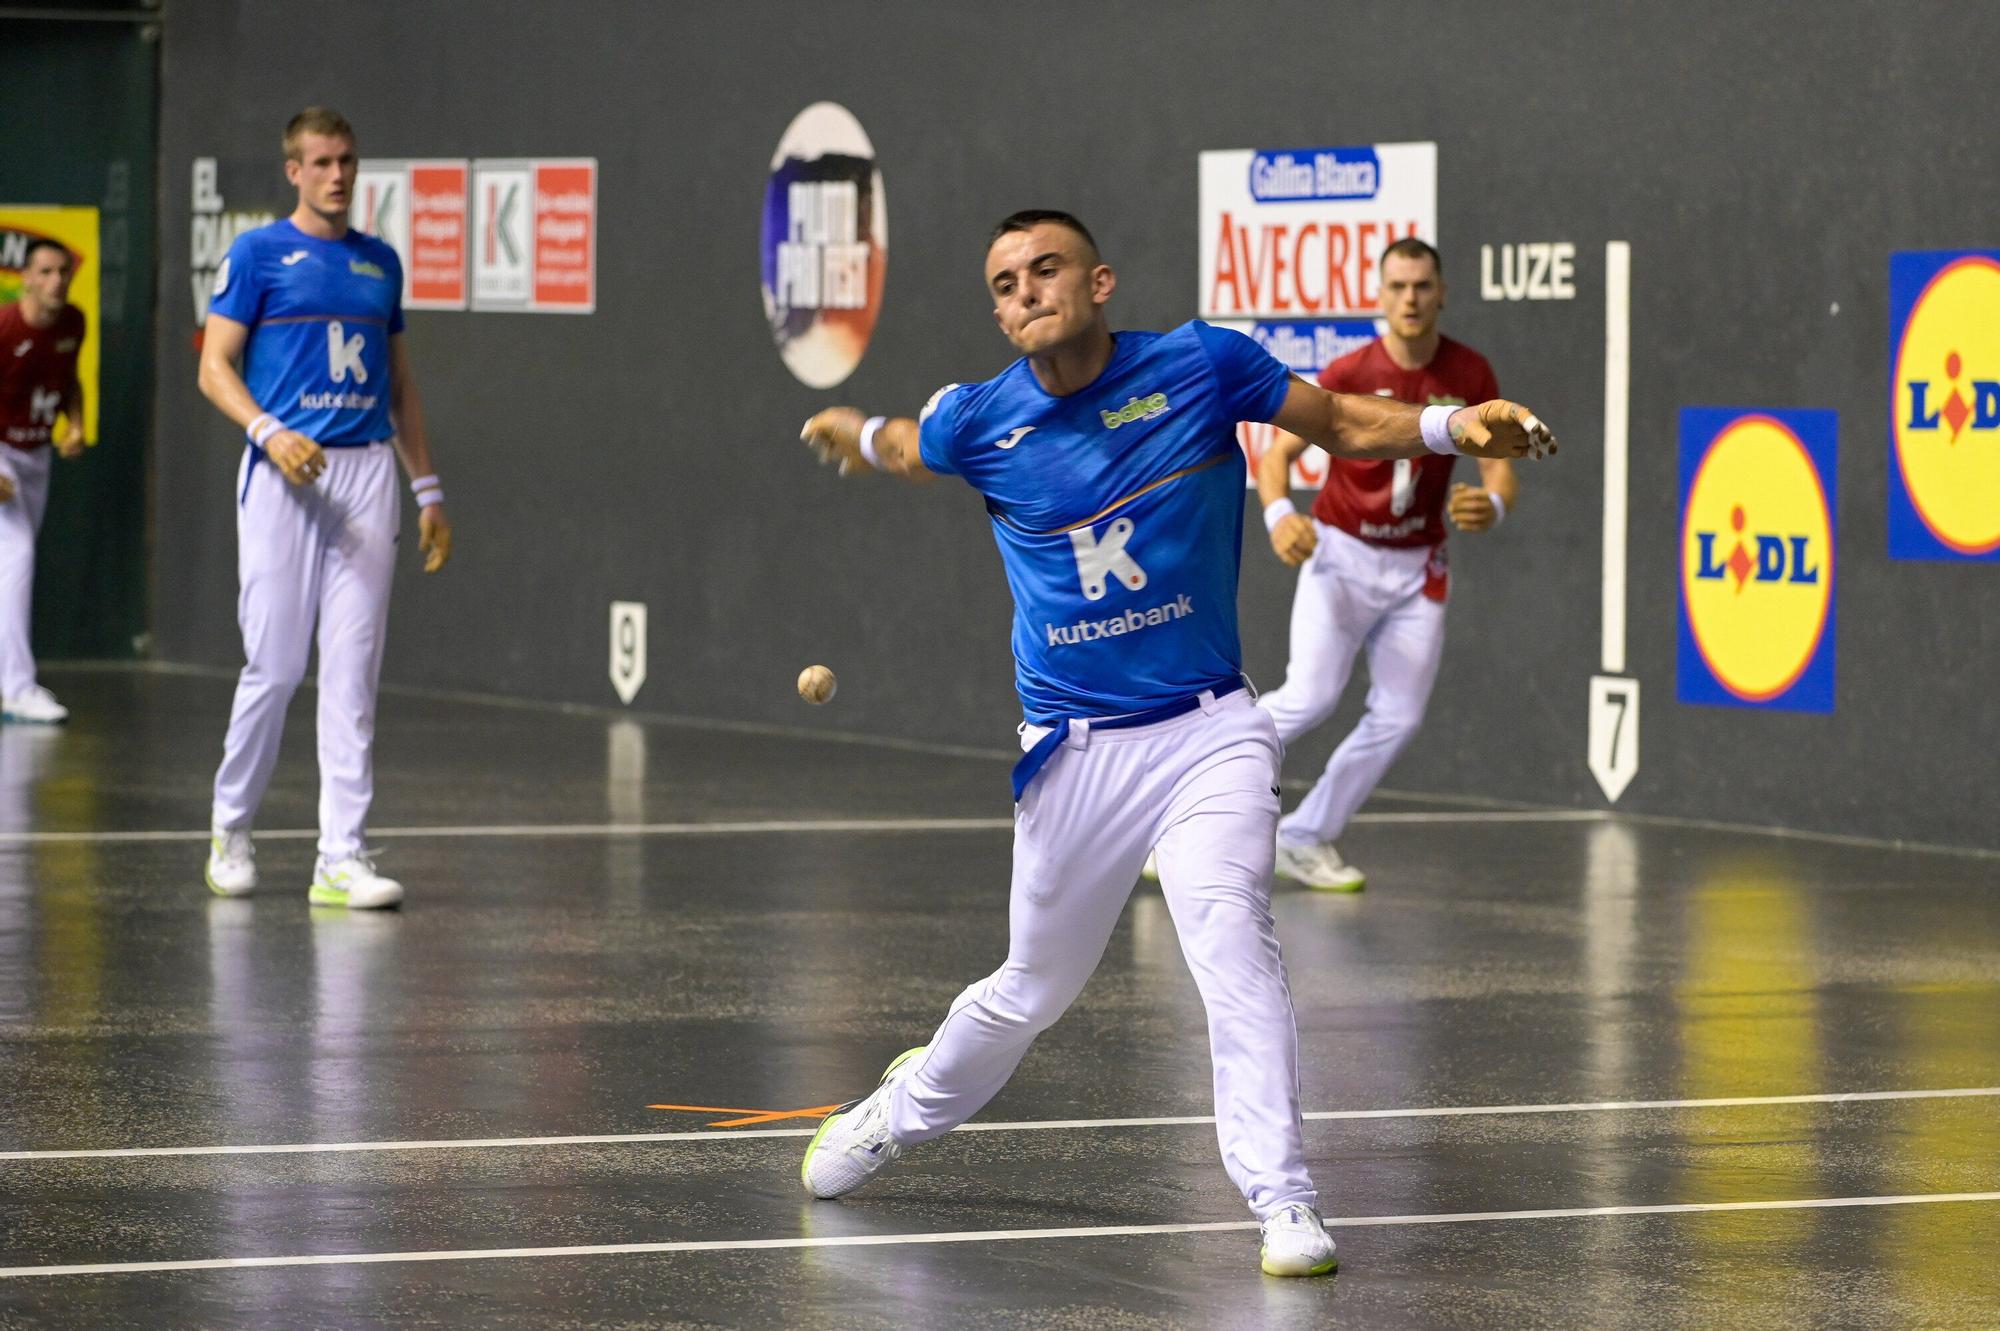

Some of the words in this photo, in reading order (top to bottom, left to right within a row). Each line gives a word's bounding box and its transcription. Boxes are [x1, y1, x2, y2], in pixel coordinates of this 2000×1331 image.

[1481, 243, 1576, 299] LUZE
[619, 615, 636, 679] 9
[1046, 594, 1194, 647] kutxabank
[1605, 692, 1627, 771] 7
